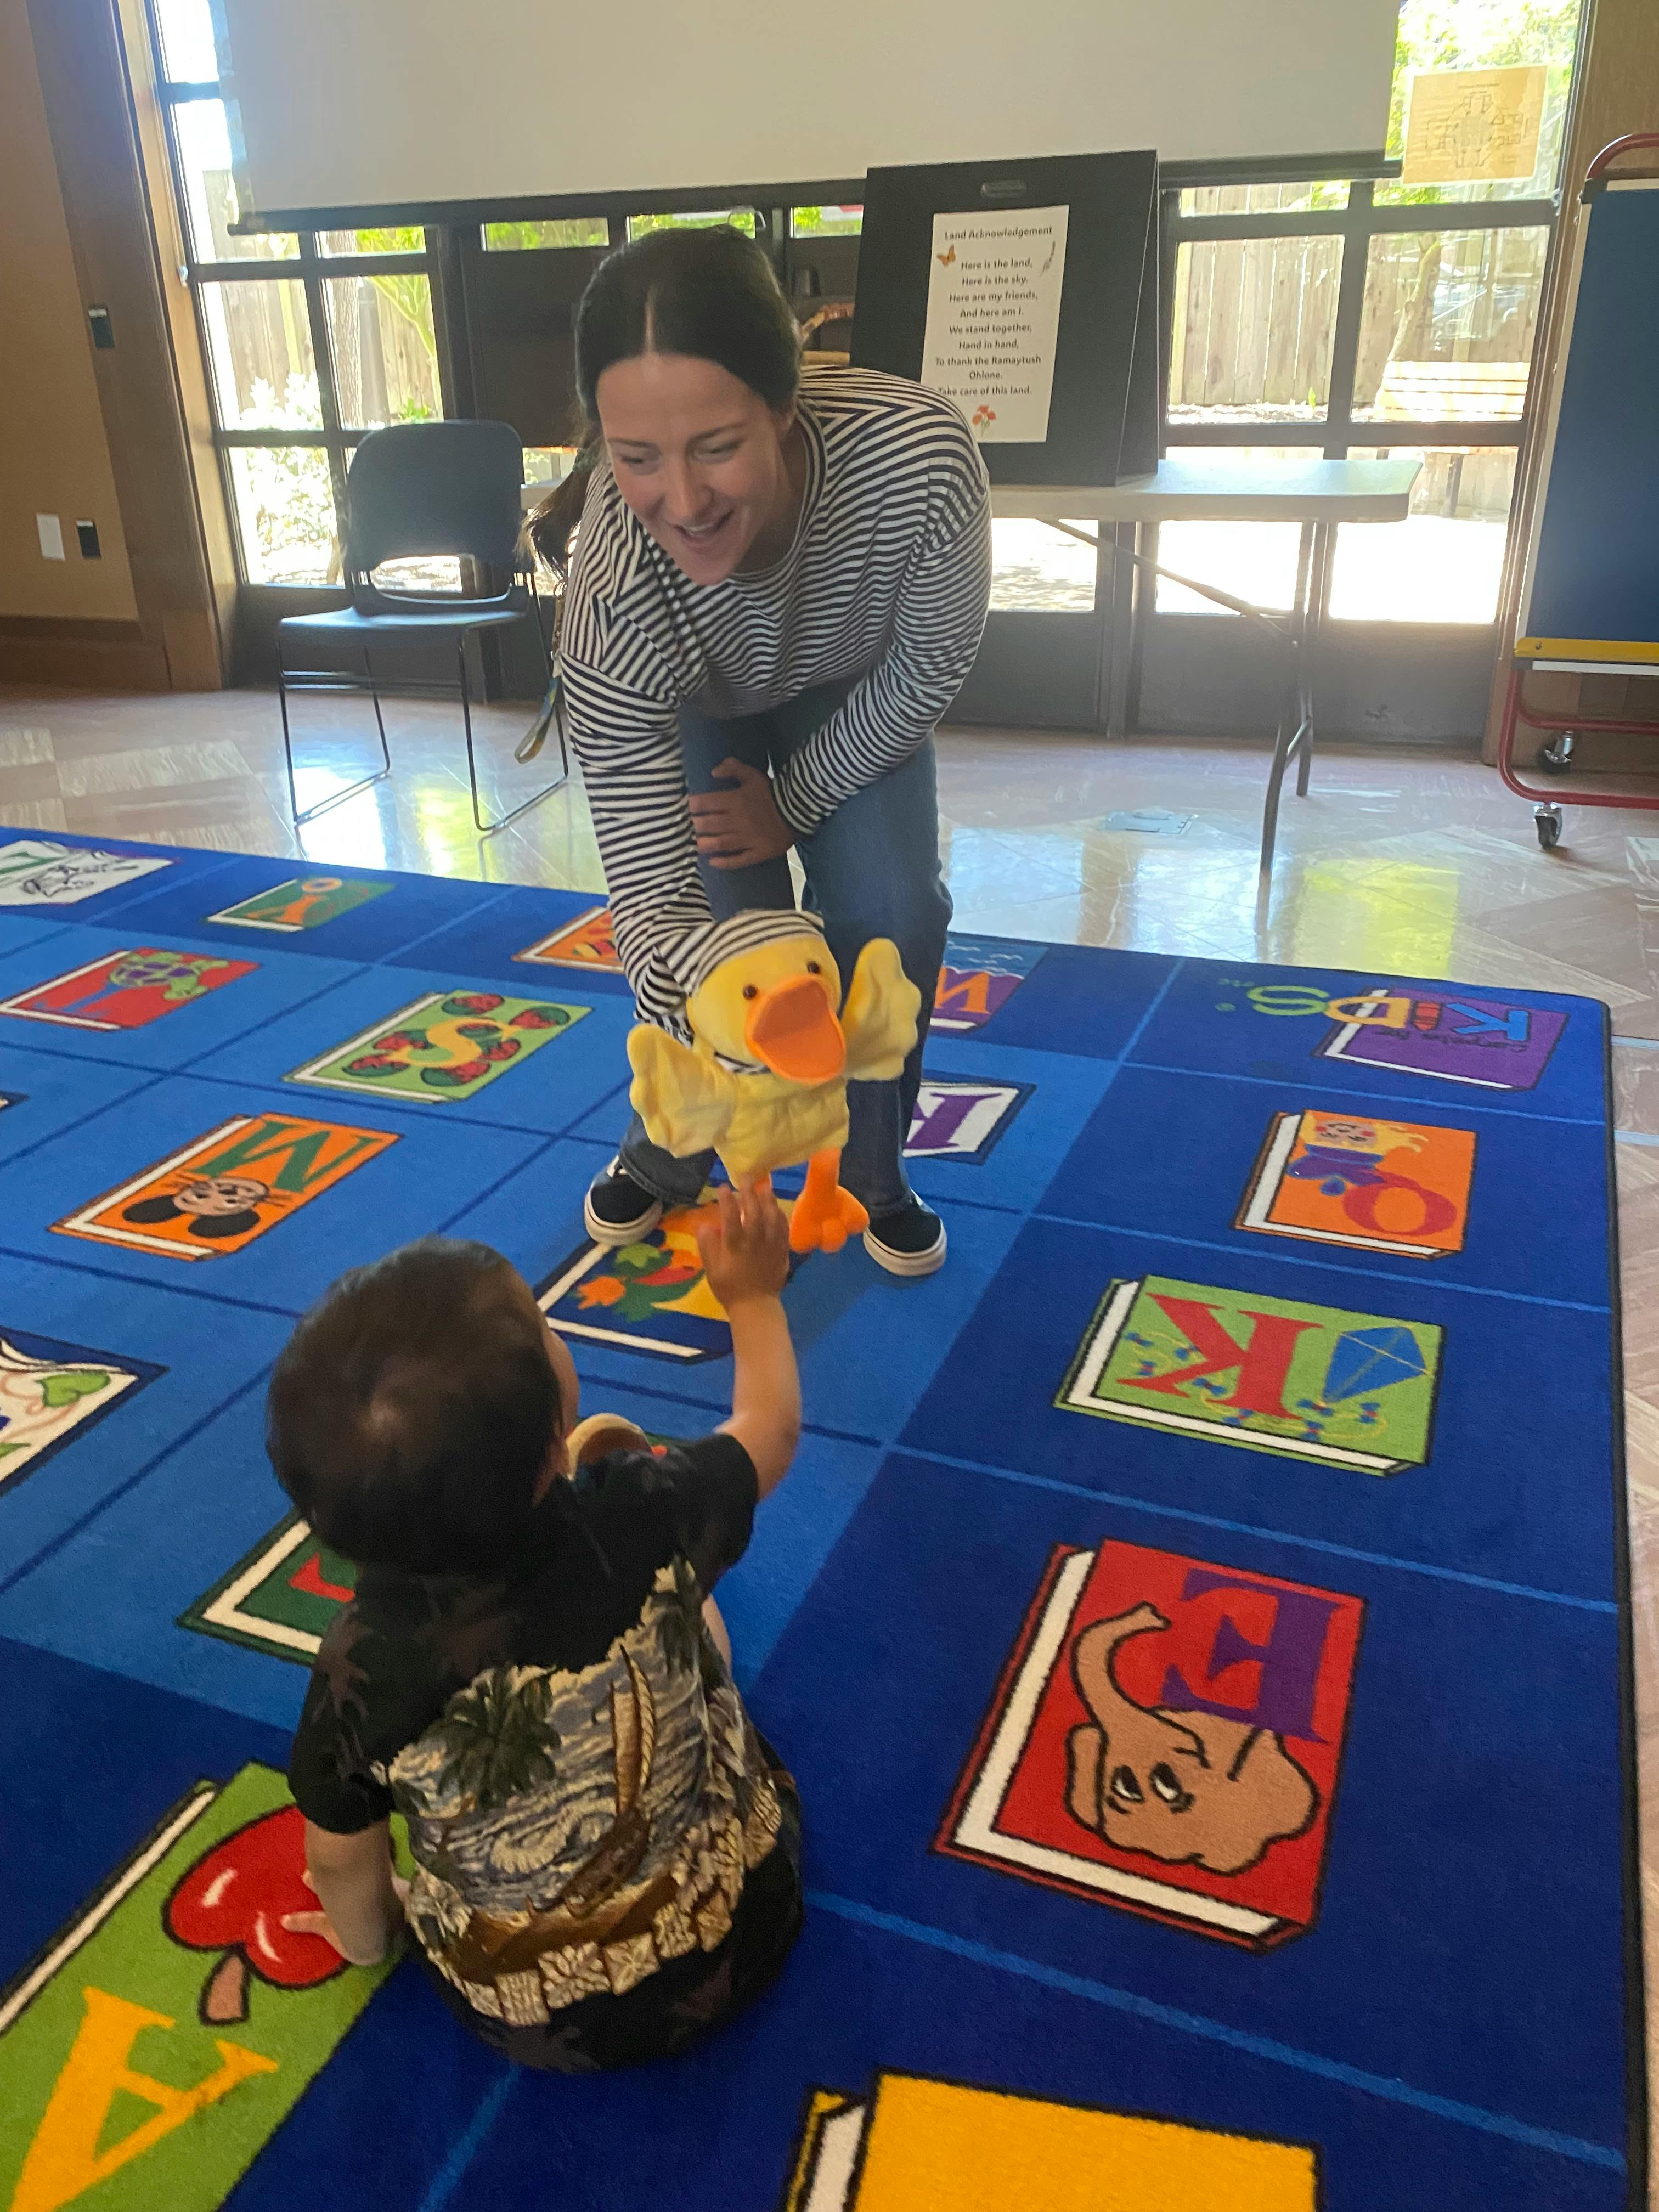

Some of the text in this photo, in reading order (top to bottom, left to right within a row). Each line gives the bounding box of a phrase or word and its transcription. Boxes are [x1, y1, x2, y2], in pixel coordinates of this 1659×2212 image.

[945, 225, 1053, 241] Land Acknowledgement
[961, 261, 981, 271] Here
[984, 260, 991, 269] is
[994, 259, 1008, 269] the
[962, 276, 983, 286] Here
[985, 276, 992, 286] is
[994, 275, 1009, 285] the
[949, 294, 969, 303] Here
[972, 294, 986, 302] are
[988, 294, 1002, 303] my
[960, 308, 978, 318] And
[980, 307, 1000, 318] here
[1002, 308, 1016, 317] am
[949, 325, 963, 335] We
[965, 324, 990, 334] stand
[958, 340, 982, 350] Hand
[984, 340, 992, 349] in
[936, 355, 1041, 366] To thank the Ramaytush
[960, 388, 978, 397] care
[980, 386, 989, 396] of
[992, 385, 1008, 396] this
[1247, 985, 1531, 1041] KIDS
[384, 1017, 524, 1069] S
[185, 1121, 381, 1193] M
[1116, 1291, 1324, 1420] K
[1159, 1568, 1346, 1745] E
[8, 1985, 279, 2212] A
